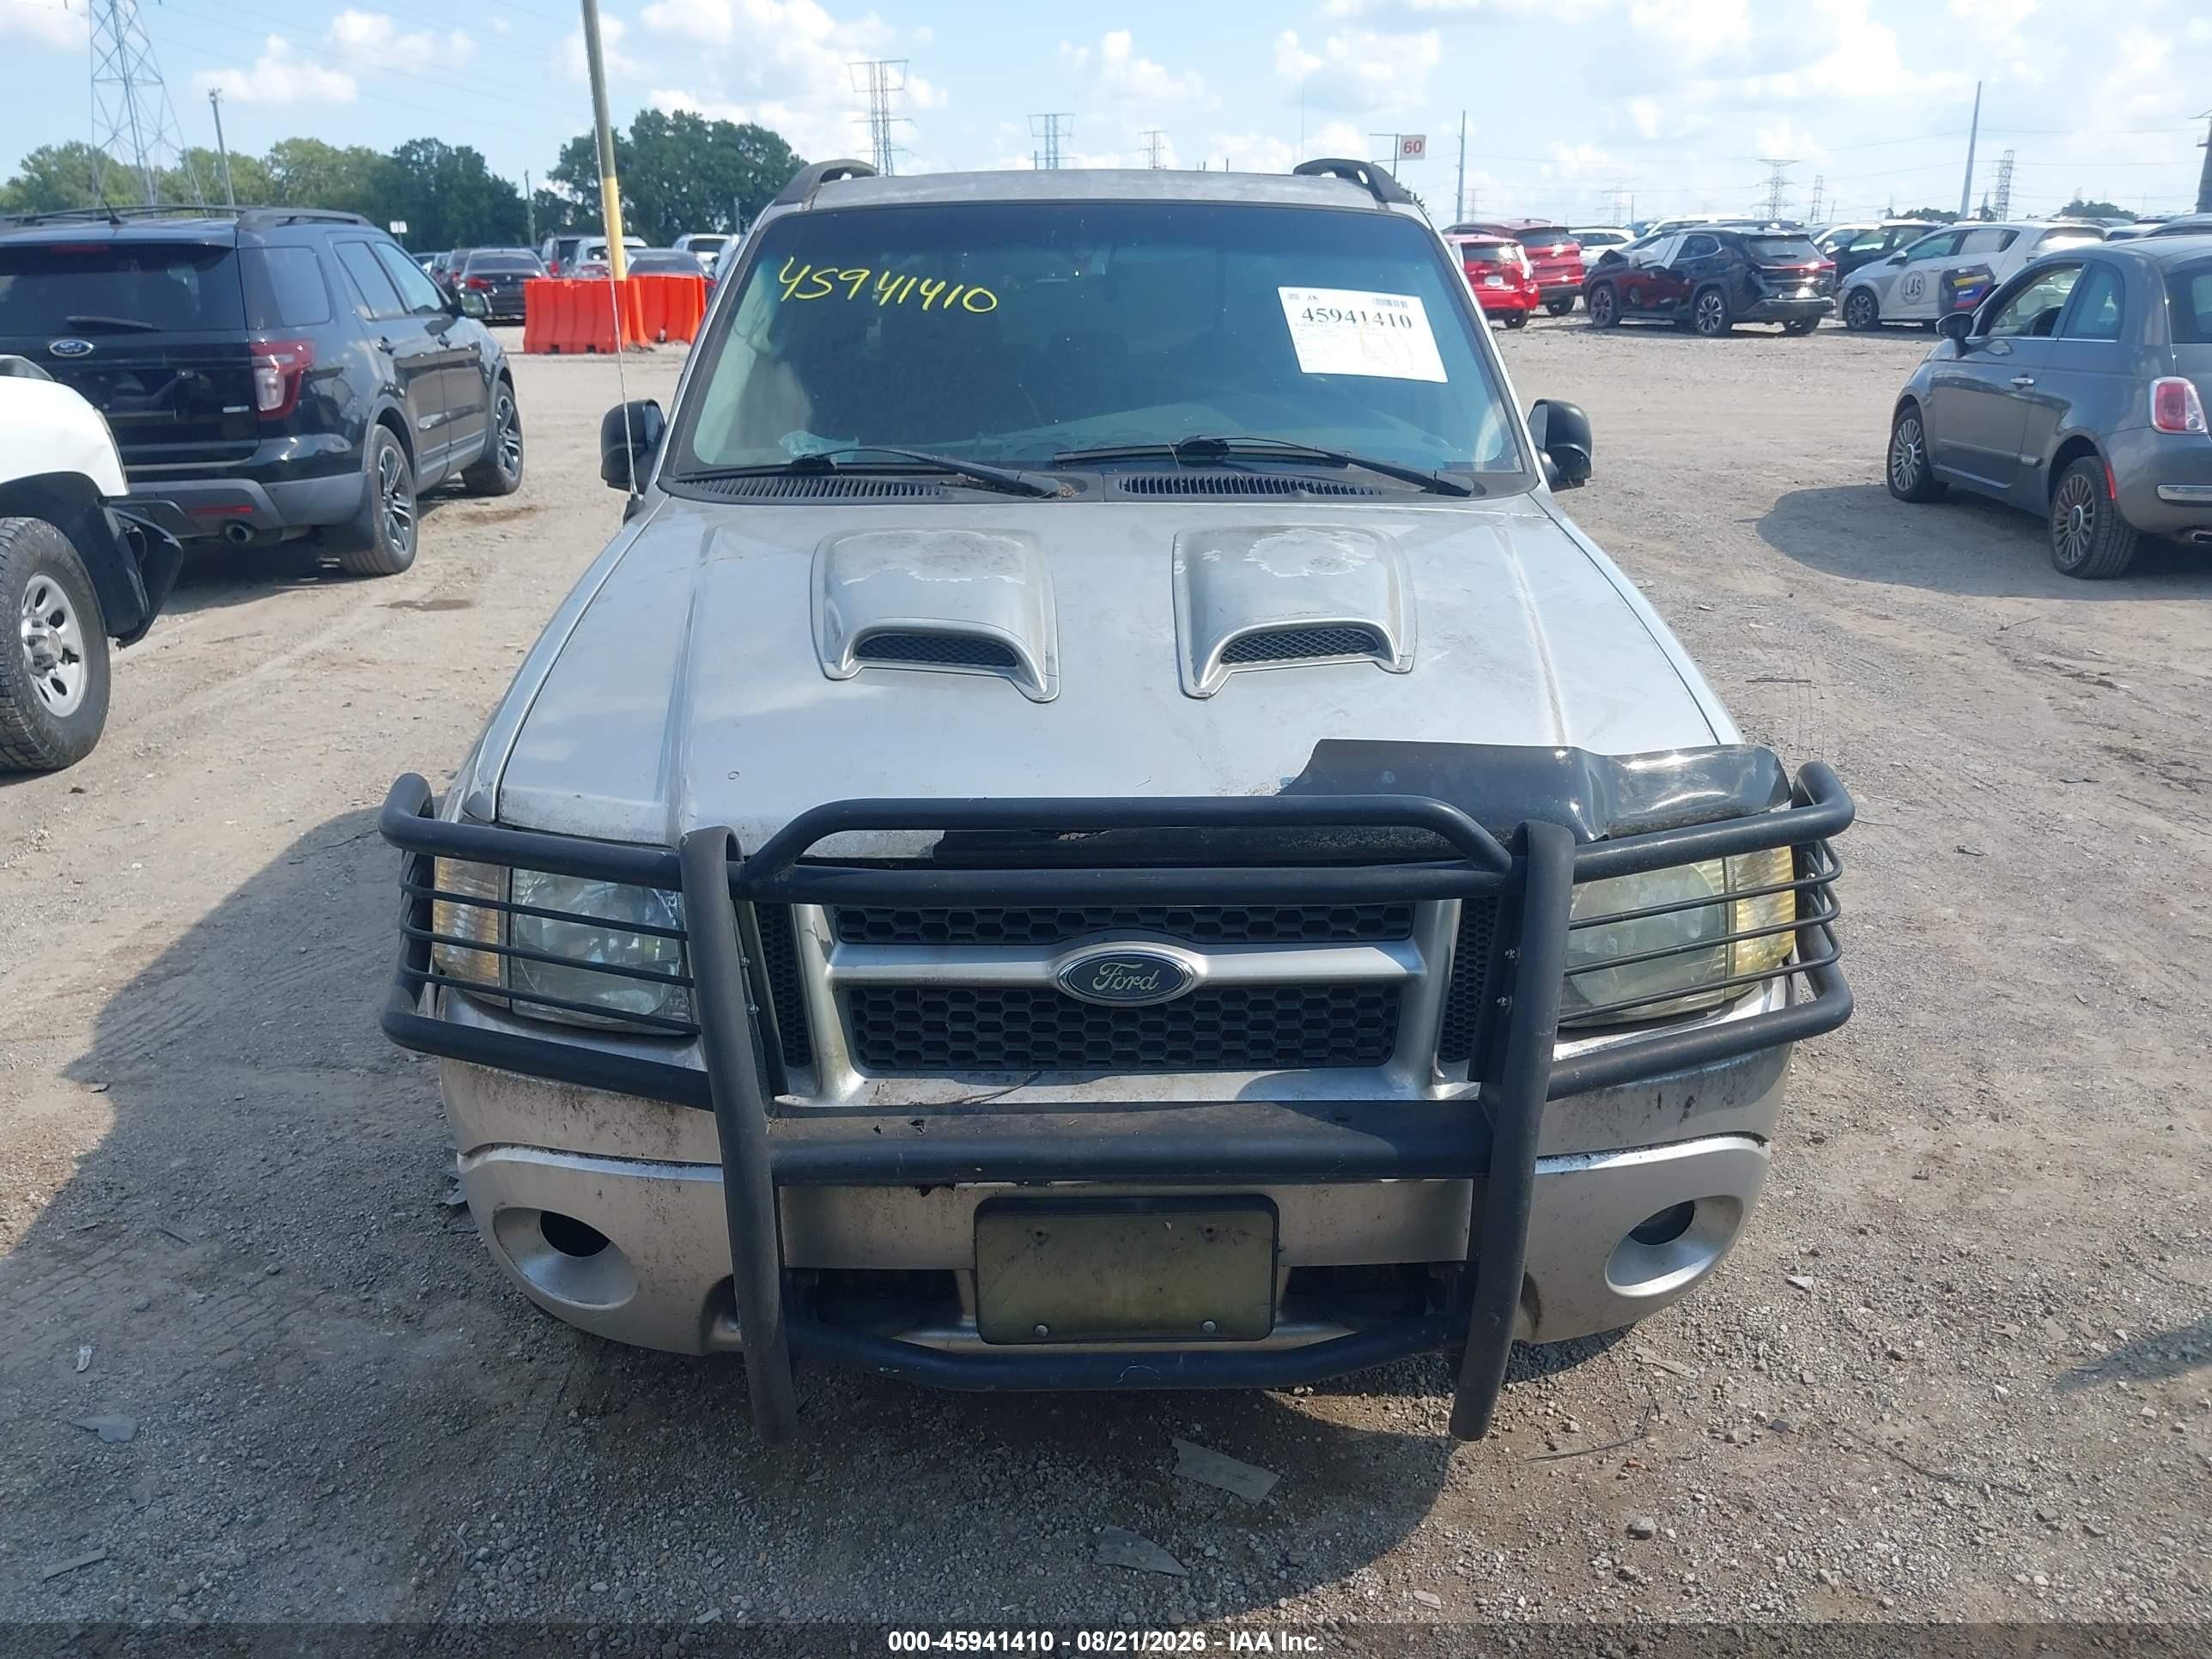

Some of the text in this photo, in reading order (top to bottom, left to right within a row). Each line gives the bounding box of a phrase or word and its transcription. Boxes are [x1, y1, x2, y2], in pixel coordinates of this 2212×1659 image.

[1404, 140, 1422, 155] 60
[778, 256, 998, 313] 45941410
[1905, 278, 1922, 297] LAS
[1301, 307, 1413, 330] 45941410
[1092, 962, 1160, 991] Ford
